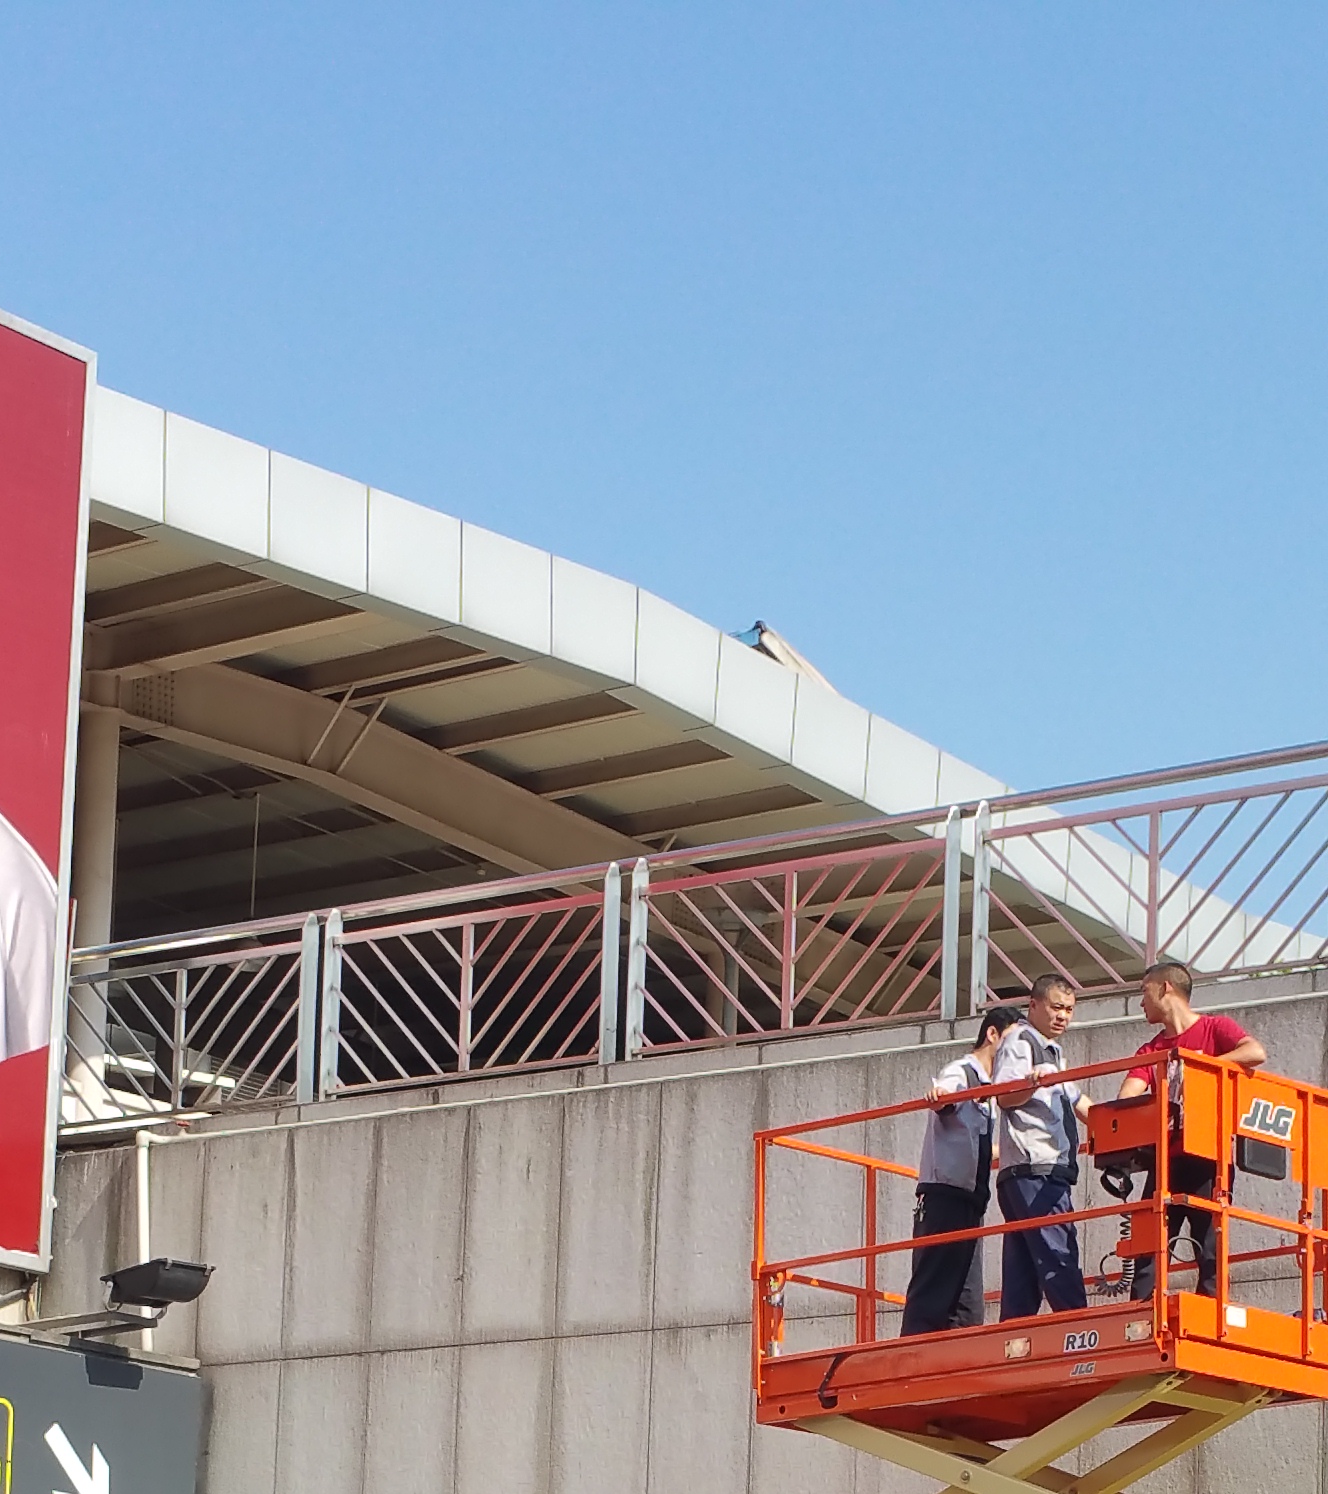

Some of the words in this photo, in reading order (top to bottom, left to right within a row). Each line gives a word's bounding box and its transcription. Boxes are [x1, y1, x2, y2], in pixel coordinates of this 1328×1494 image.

[1240, 1098, 1296, 1140] JLG
[1063, 1330, 1099, 1352] R10
[1070, 1361, 1096, 1377] JLG
